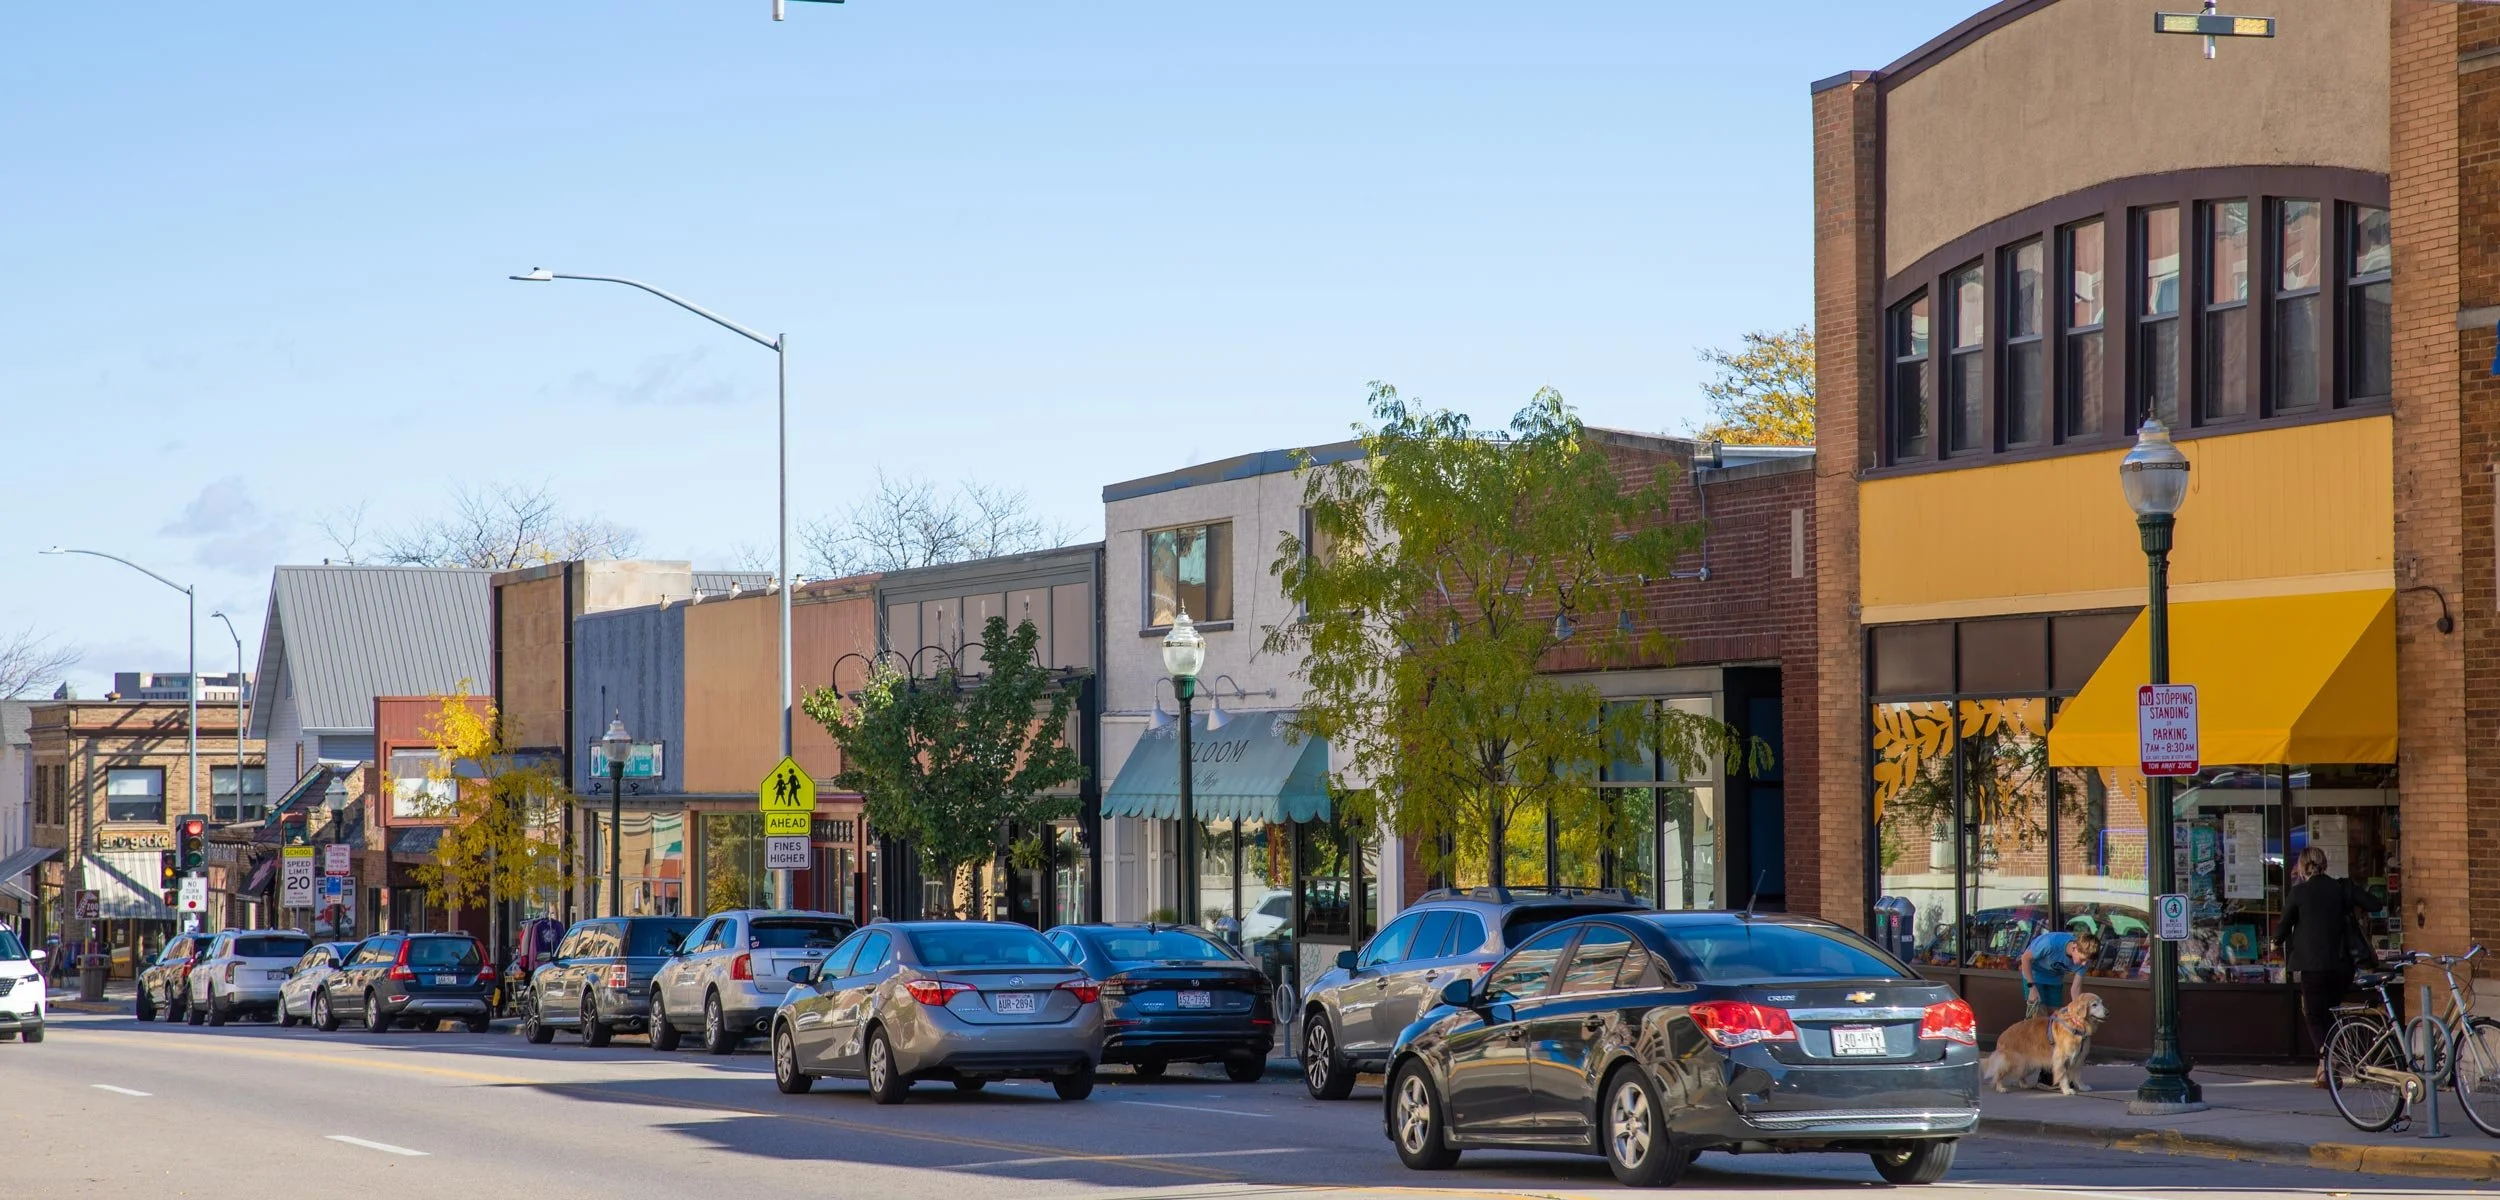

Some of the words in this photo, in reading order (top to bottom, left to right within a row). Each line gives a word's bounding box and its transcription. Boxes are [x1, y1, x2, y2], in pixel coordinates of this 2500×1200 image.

[2141, 692, 2153, 705] NO
[2155, 692, 2193, 705] STOPPING
[2150, 706, 2189, 719] STANDING
[2152, 728, 2188, 741] PARKING
[770, 818, 807, 828] AHEAD
[774, 842, 802, 851] FINES
[770, 854, 805, 863] HIGHER
[287, 876, 310, 890] 20
[87, 903, 99, 911] ZOO
